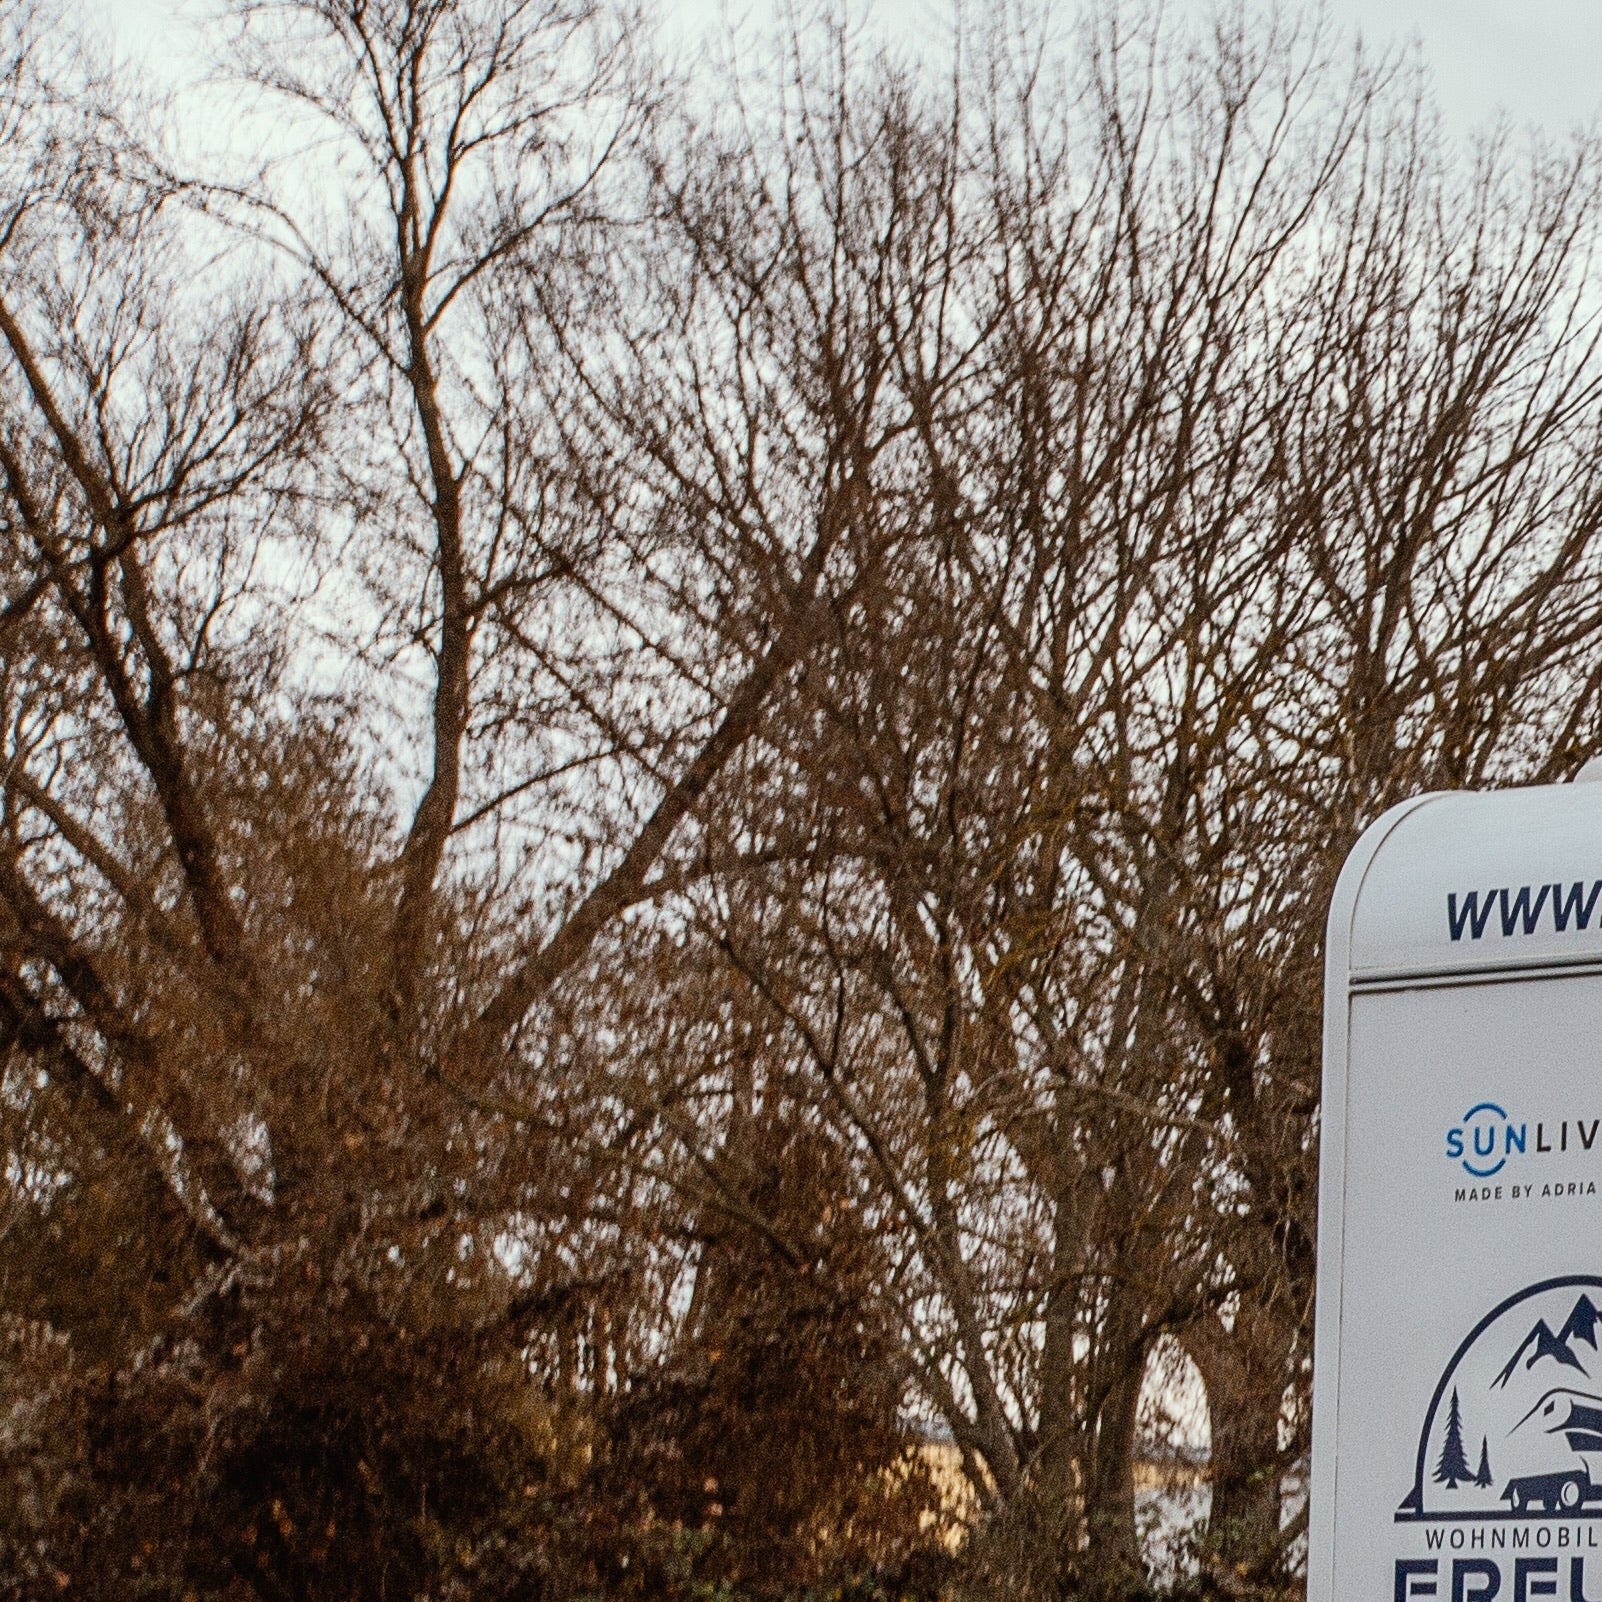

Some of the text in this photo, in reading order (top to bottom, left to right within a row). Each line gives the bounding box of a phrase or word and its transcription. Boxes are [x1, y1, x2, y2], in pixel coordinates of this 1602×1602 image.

[1454, 1186, 1503, 1202] MADE
[1512, 1184, 1533, 1198] BY
[1541, 1181, 1597, 1197] ADRIA
[1426, 1527, 1598, 1549] WOHNMOBIL
